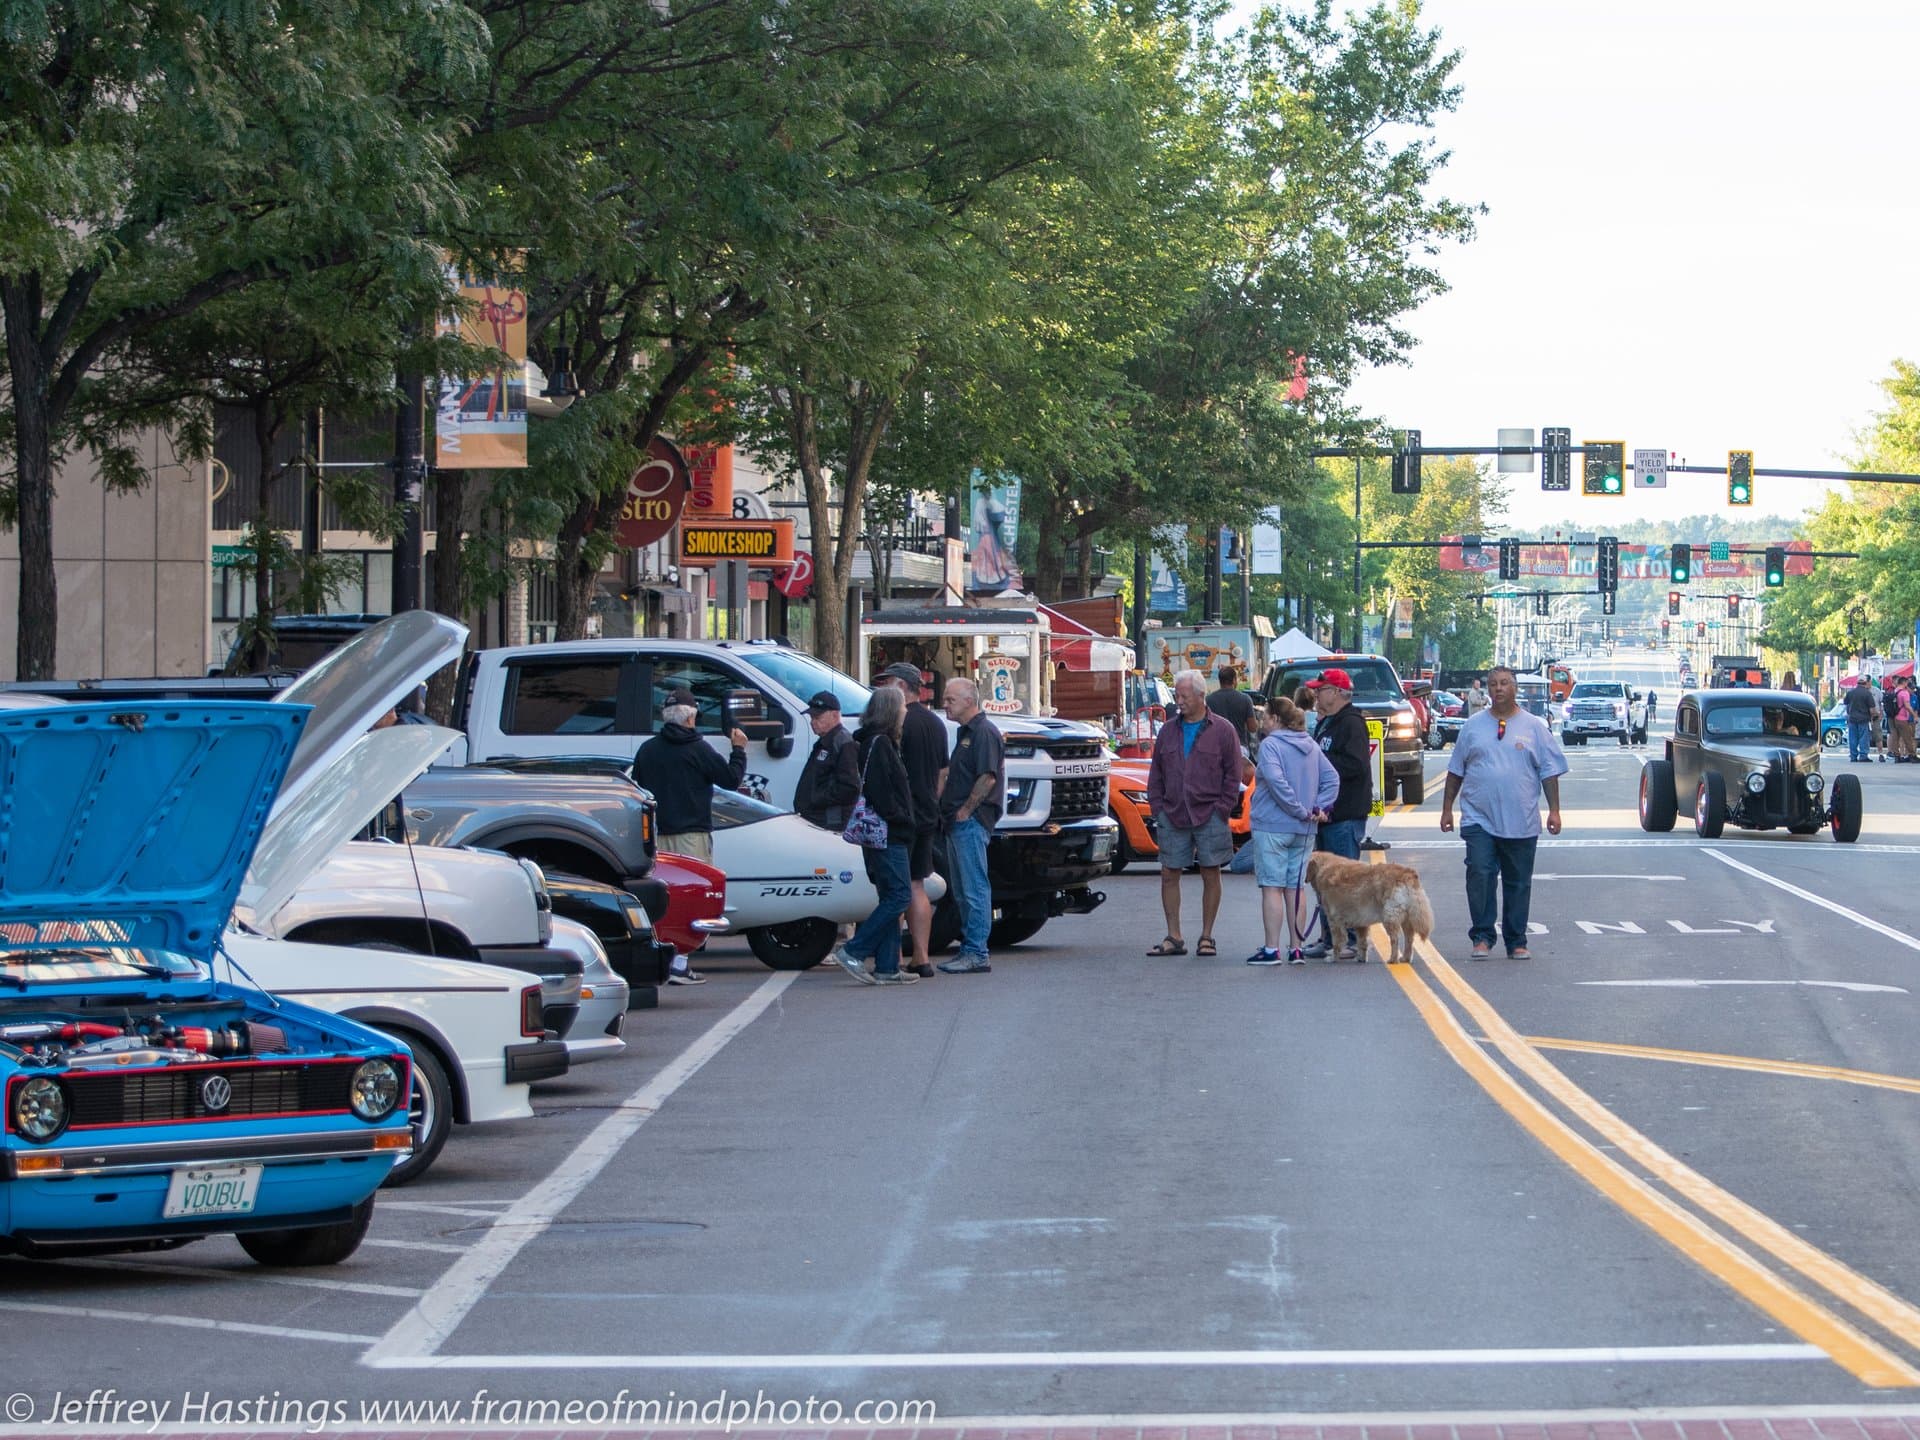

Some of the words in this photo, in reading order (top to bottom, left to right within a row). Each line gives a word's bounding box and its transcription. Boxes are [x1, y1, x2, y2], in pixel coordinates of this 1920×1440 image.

[687, 531, 773, 555] SMOKESHOP
[1568, 559, 1704, 577] DONTON
[988, 658, 1018, 668] SLUSH
[984, 702, 1020, 712] PUPPIE
[760, 886, 832, 897] PULSE
[183, 1181, 246, 1209] VDUBU
